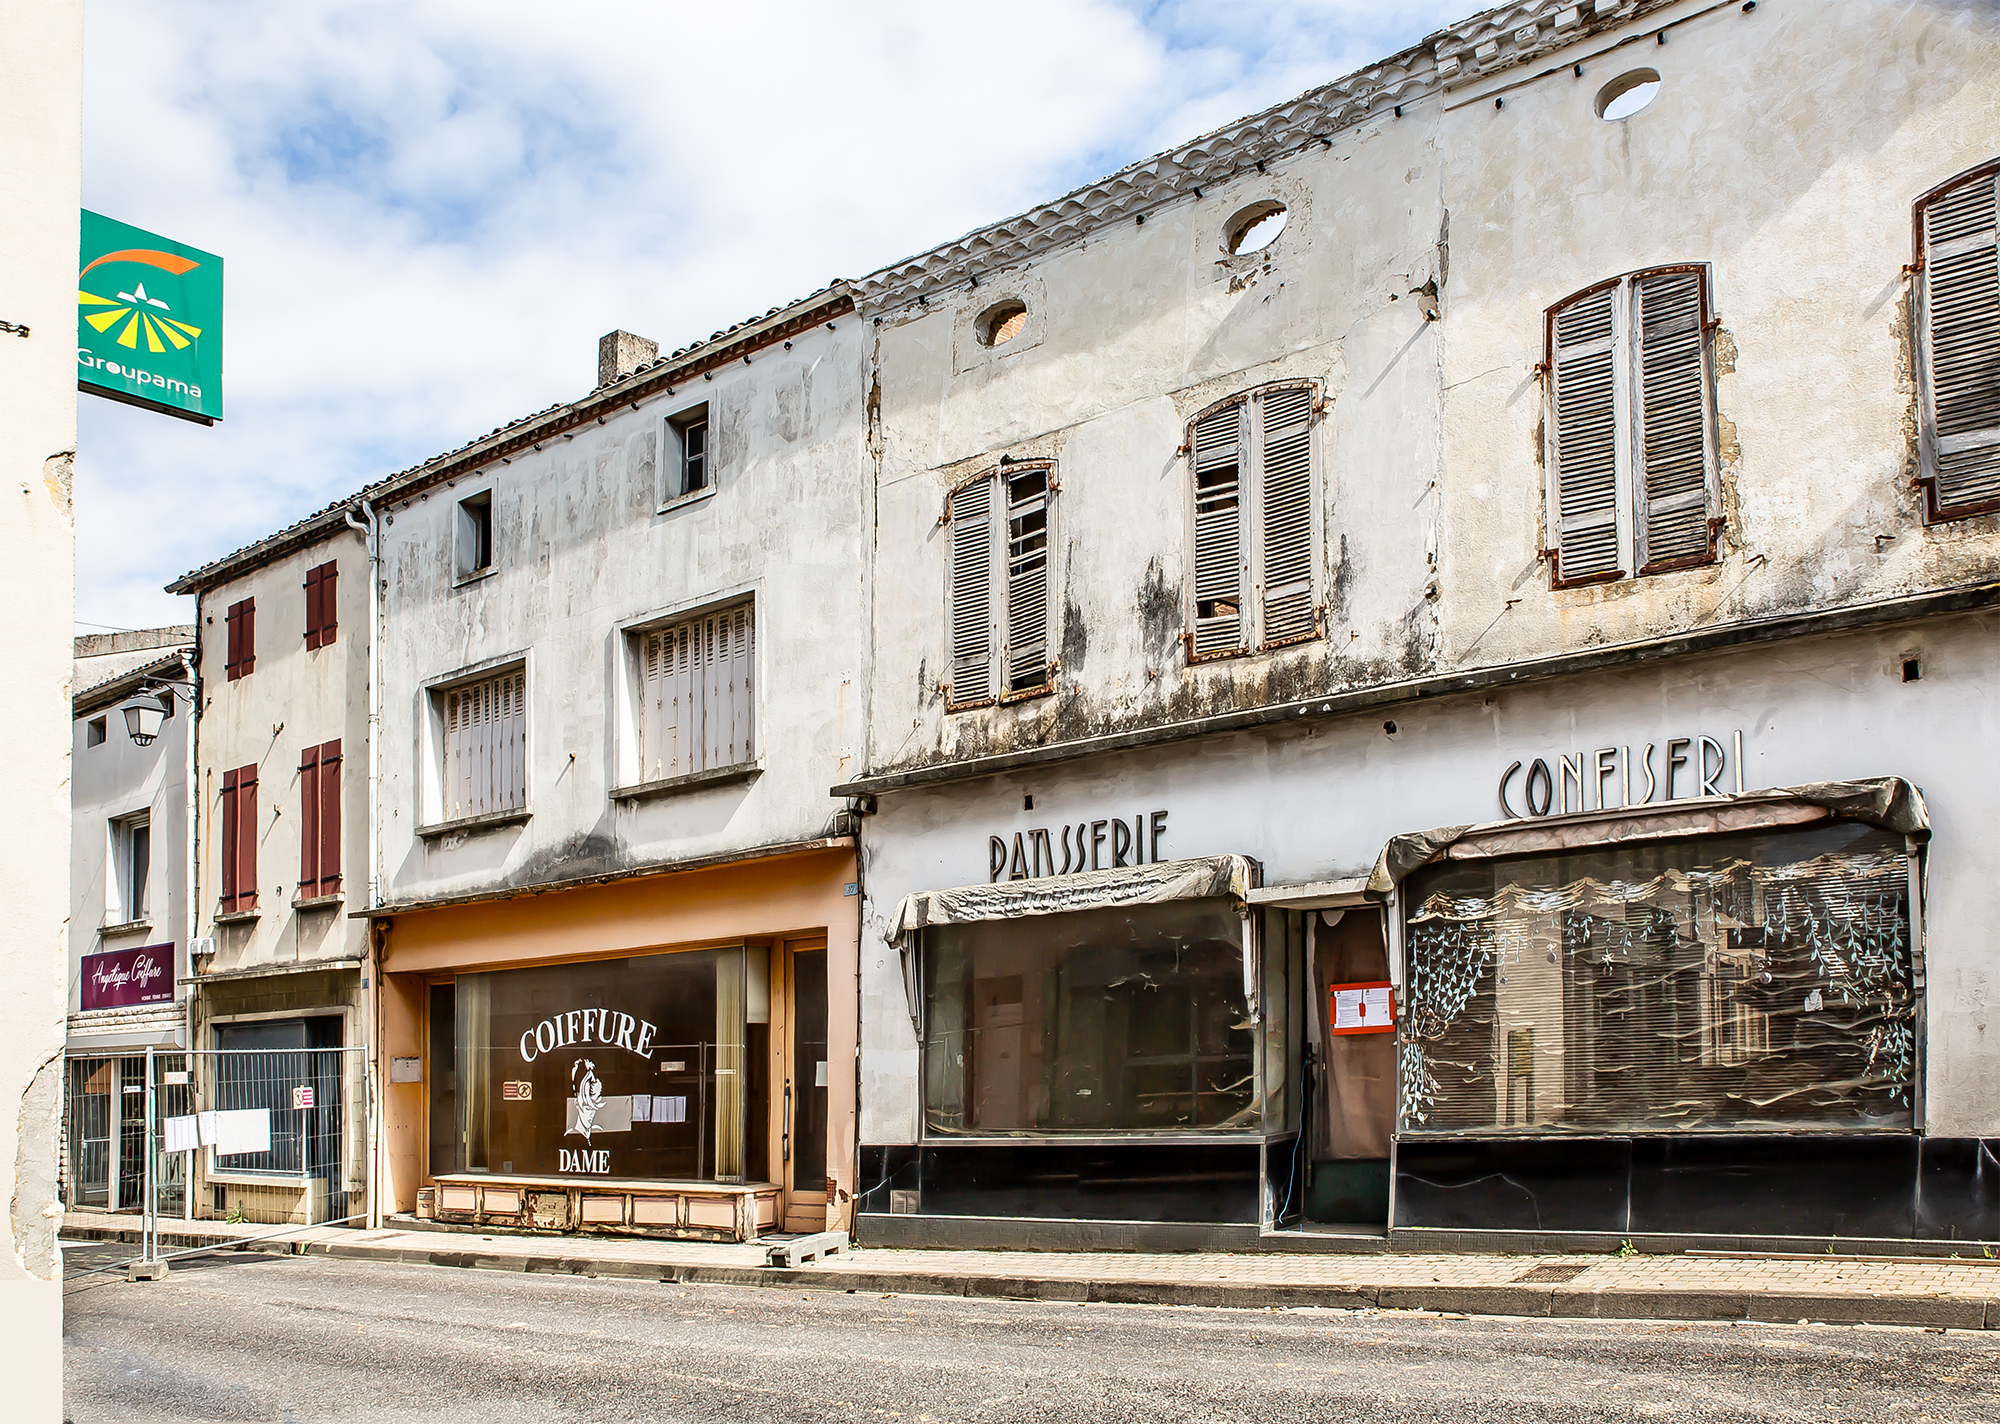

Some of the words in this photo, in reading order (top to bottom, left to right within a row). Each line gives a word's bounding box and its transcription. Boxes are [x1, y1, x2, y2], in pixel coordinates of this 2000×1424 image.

[76, 347, 203, 399] Groupama
[989, 812, 1172, 881] PATISSERIE
[519, 1007, 658, 1063] COIFFURE
[559, 1149, 611, 1177] DAME
